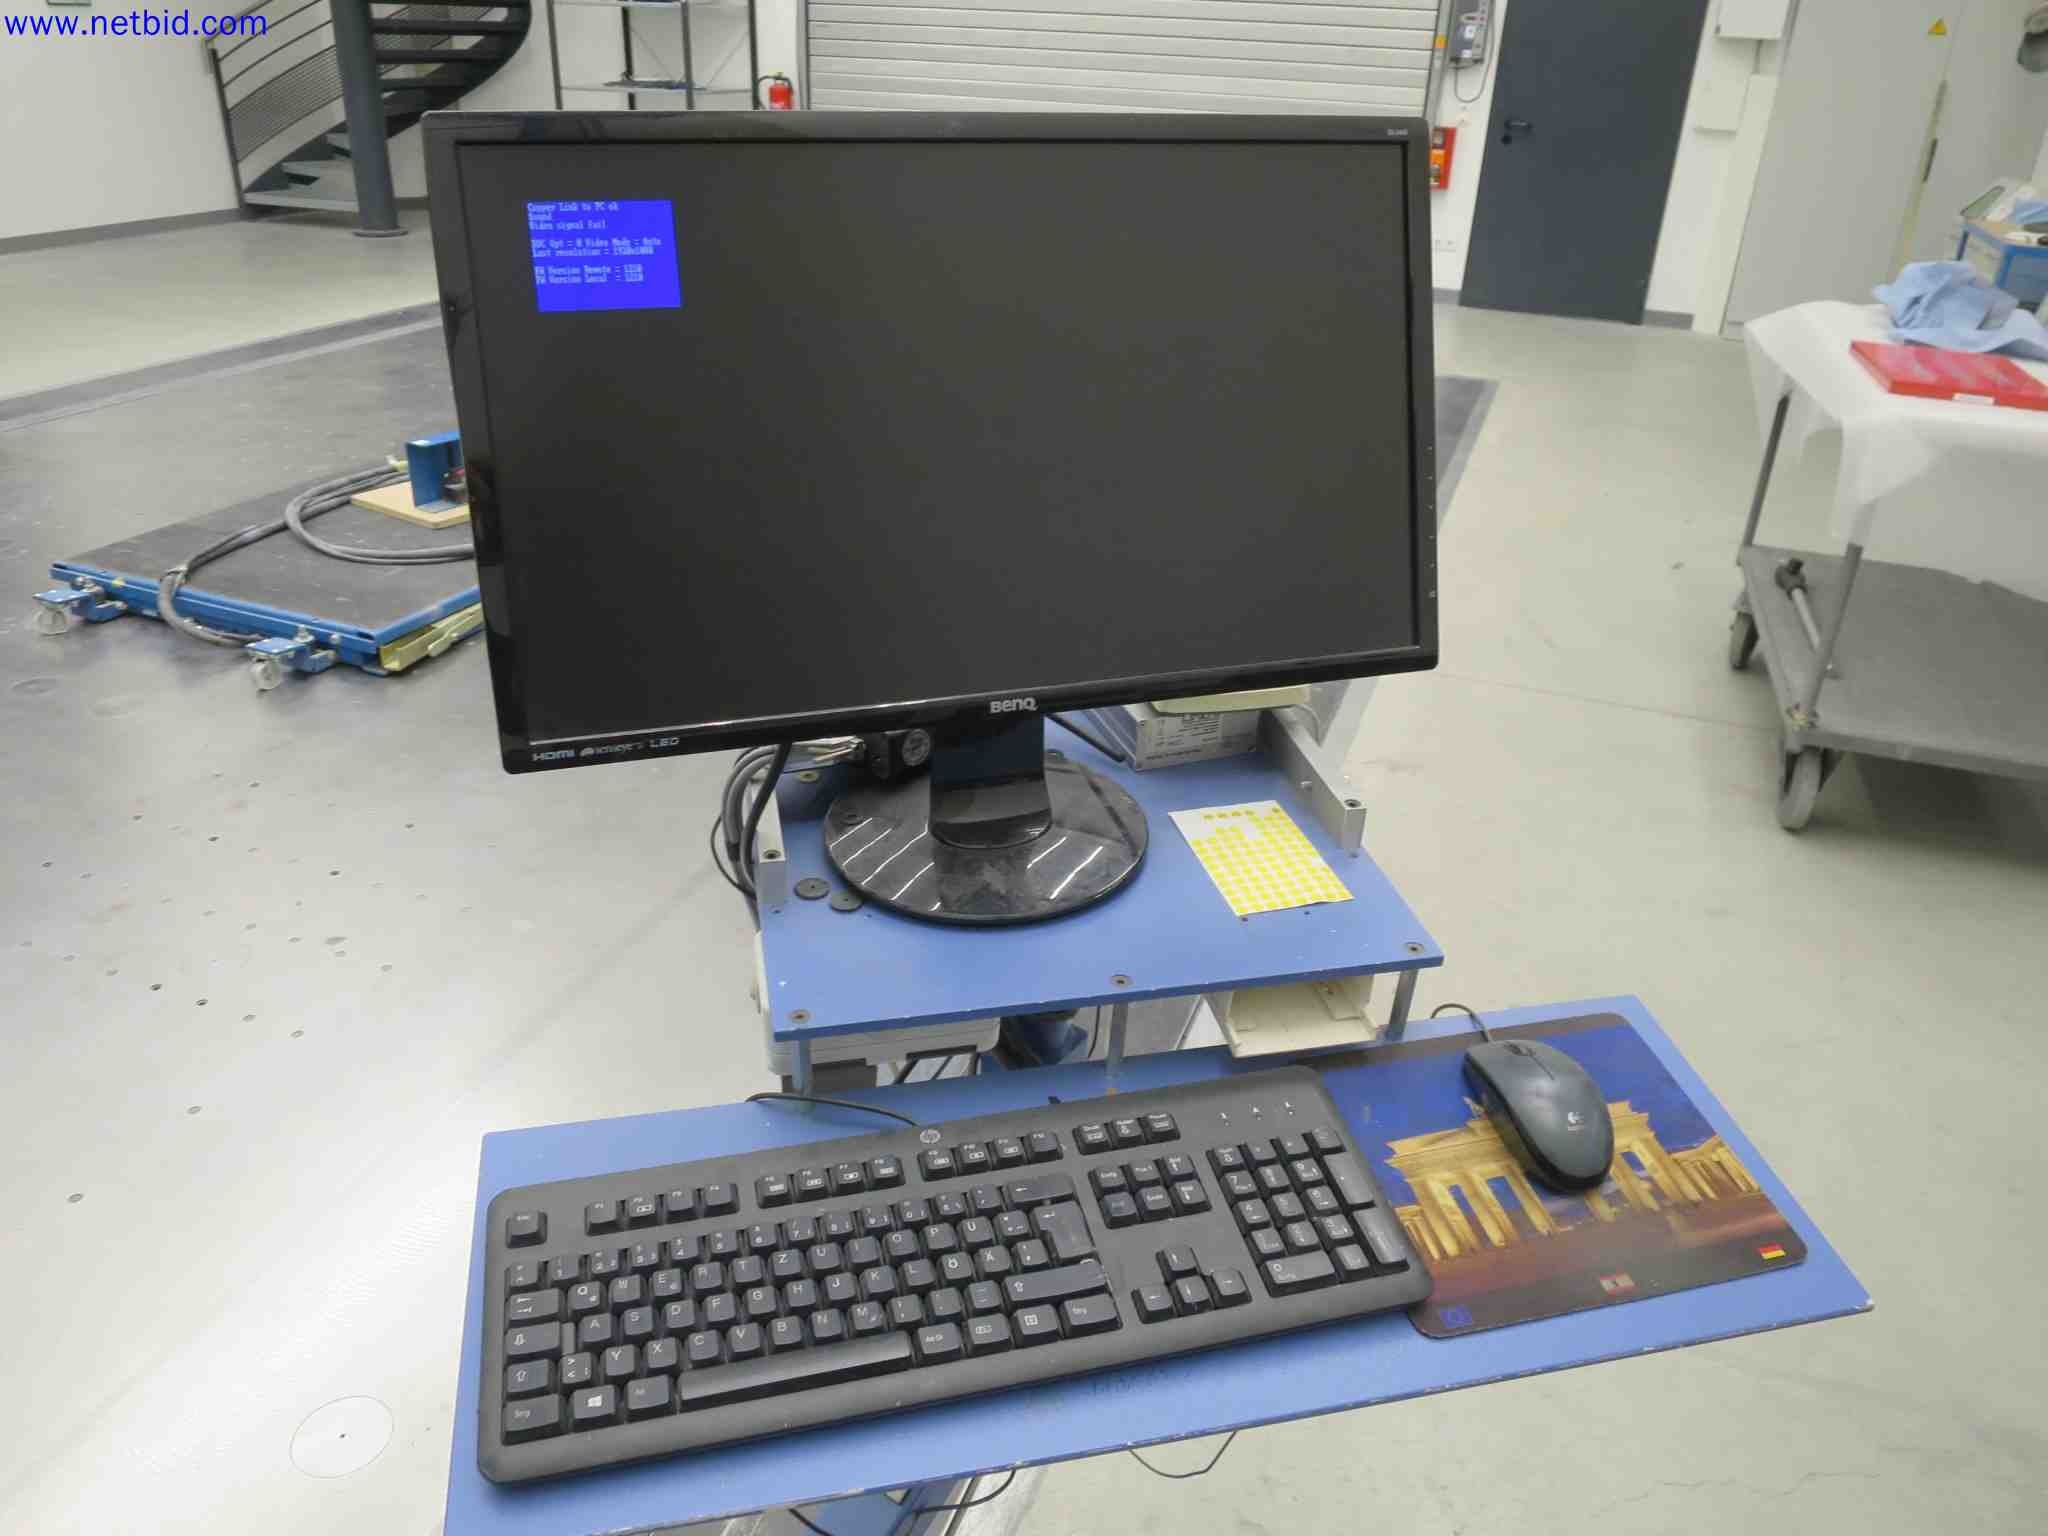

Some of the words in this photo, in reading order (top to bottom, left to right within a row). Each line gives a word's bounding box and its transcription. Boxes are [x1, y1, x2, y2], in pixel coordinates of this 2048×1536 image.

[989, 697, 1039, 714] BenQ
[532, 749, 575, 761] HDMI
[649, 737, 680, 749] LED
[930, 1227, 939, 1236] P
[816, 1247, 826, 1257] U
[778, 1253, 789, 1264] Z
[738, 1260, 748, 1270] T
[908, 1264, 918, 1274] L
[658, 1273, 666, 1284] E
[871, 1271, 880, 1281] K
[617, 1279, 628, 1289] W
[832, 1278, 840, 1288] J
[792, 1284, 803, 1295] H
[753, 1291, 763, 1301] G
[712, 1298, 721, 1308] F
[671, 1306, 681, 1316] D
[630, 1312, 640, 1322] S
[817, 1315, 828, 1324] N
[590, 1320, 601, 1329] A
[777, 1321, 788, 1332] B
[736, 1329, 746, 1339] V
[694, 1335, 705, 1346] C
[653, 1343, 662, 1353] X
[611, 1350, 622, 1361] Y
